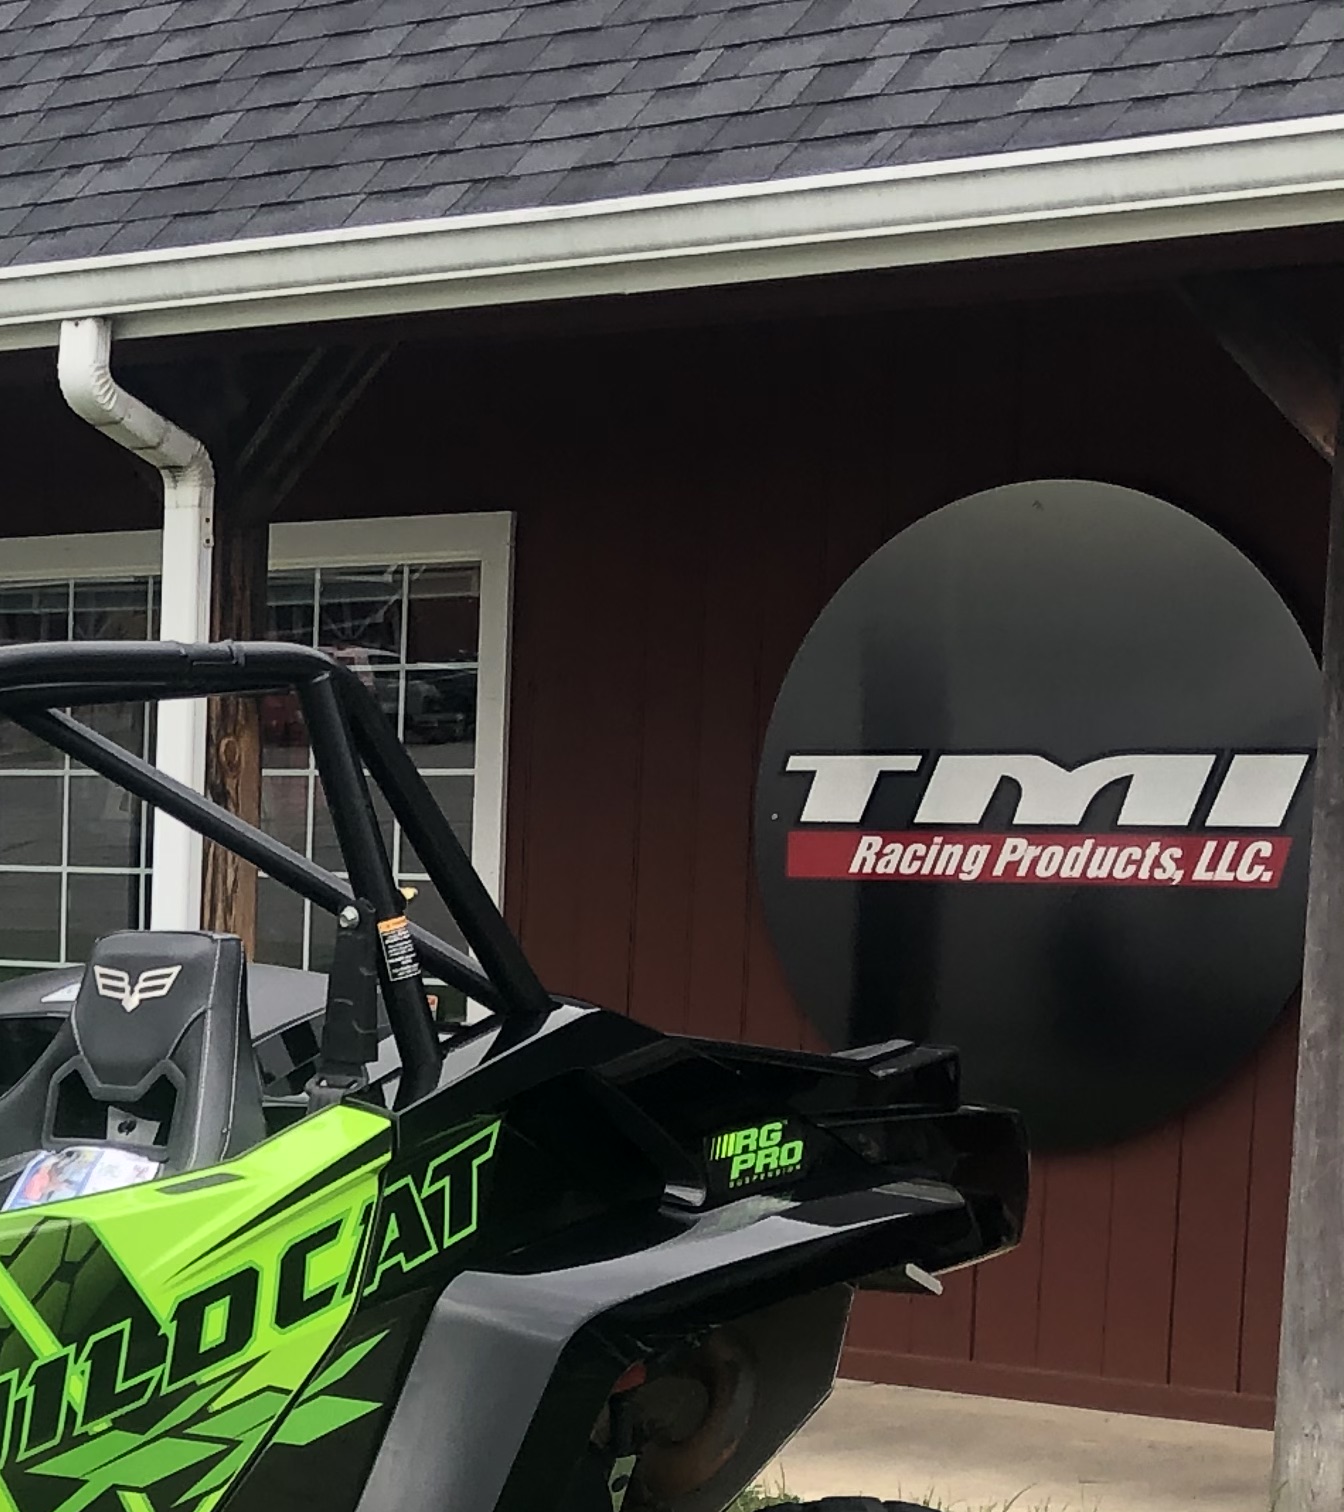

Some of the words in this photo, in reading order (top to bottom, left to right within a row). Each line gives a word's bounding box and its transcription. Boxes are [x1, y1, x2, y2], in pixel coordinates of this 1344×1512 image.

[784, 755, 1309, 827] TMI
[848, 835, 992, 882] Racing
[992, 838, 1184, 886] Products,
[1190, 841, 1274, 884] LLC.
[728, 1164, 802, 1189] SUSPENSION
[730, 1140, 804, 1180] PRO
